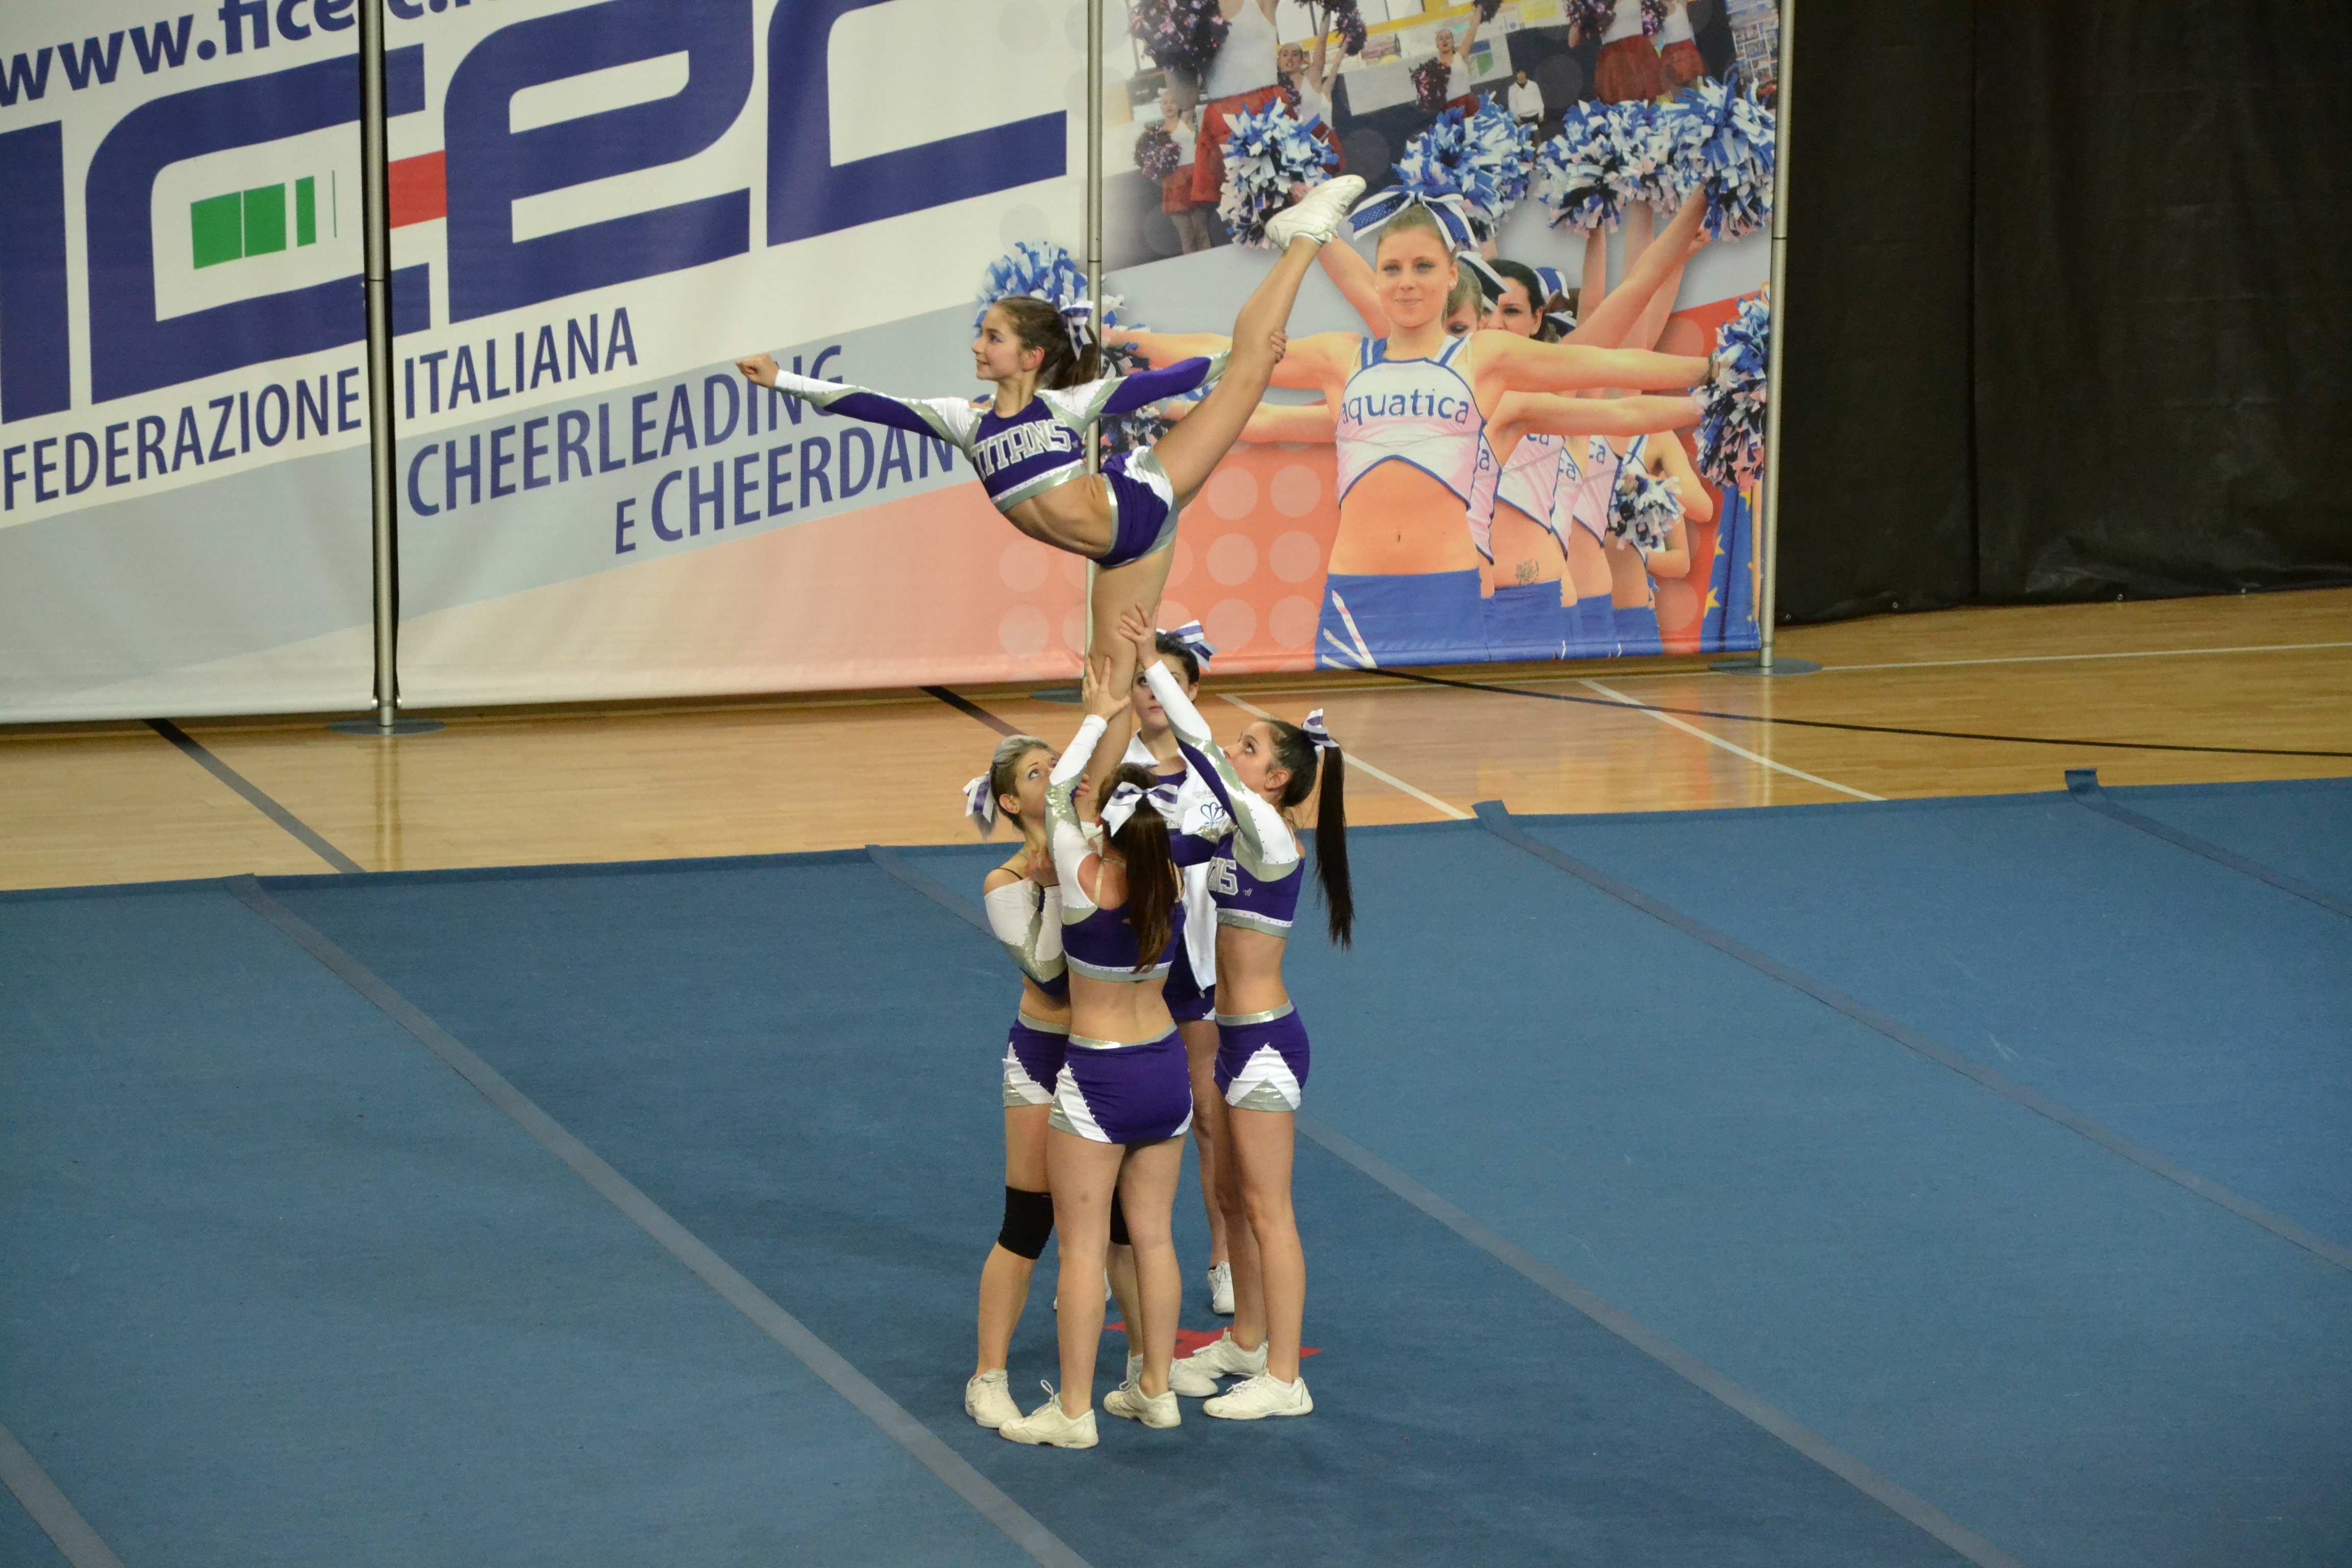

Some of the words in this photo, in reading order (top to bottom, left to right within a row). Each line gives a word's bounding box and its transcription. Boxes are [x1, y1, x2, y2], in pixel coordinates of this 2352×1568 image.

[3, 367, 361, 511] FEDERAZIONE
[404, 307, 638, 420] ITALIANA
[616, 498, 636, 554] E
[651, 394, 991, 543] CHEERDAN
[970, 418, 1072, 481] TITANS
